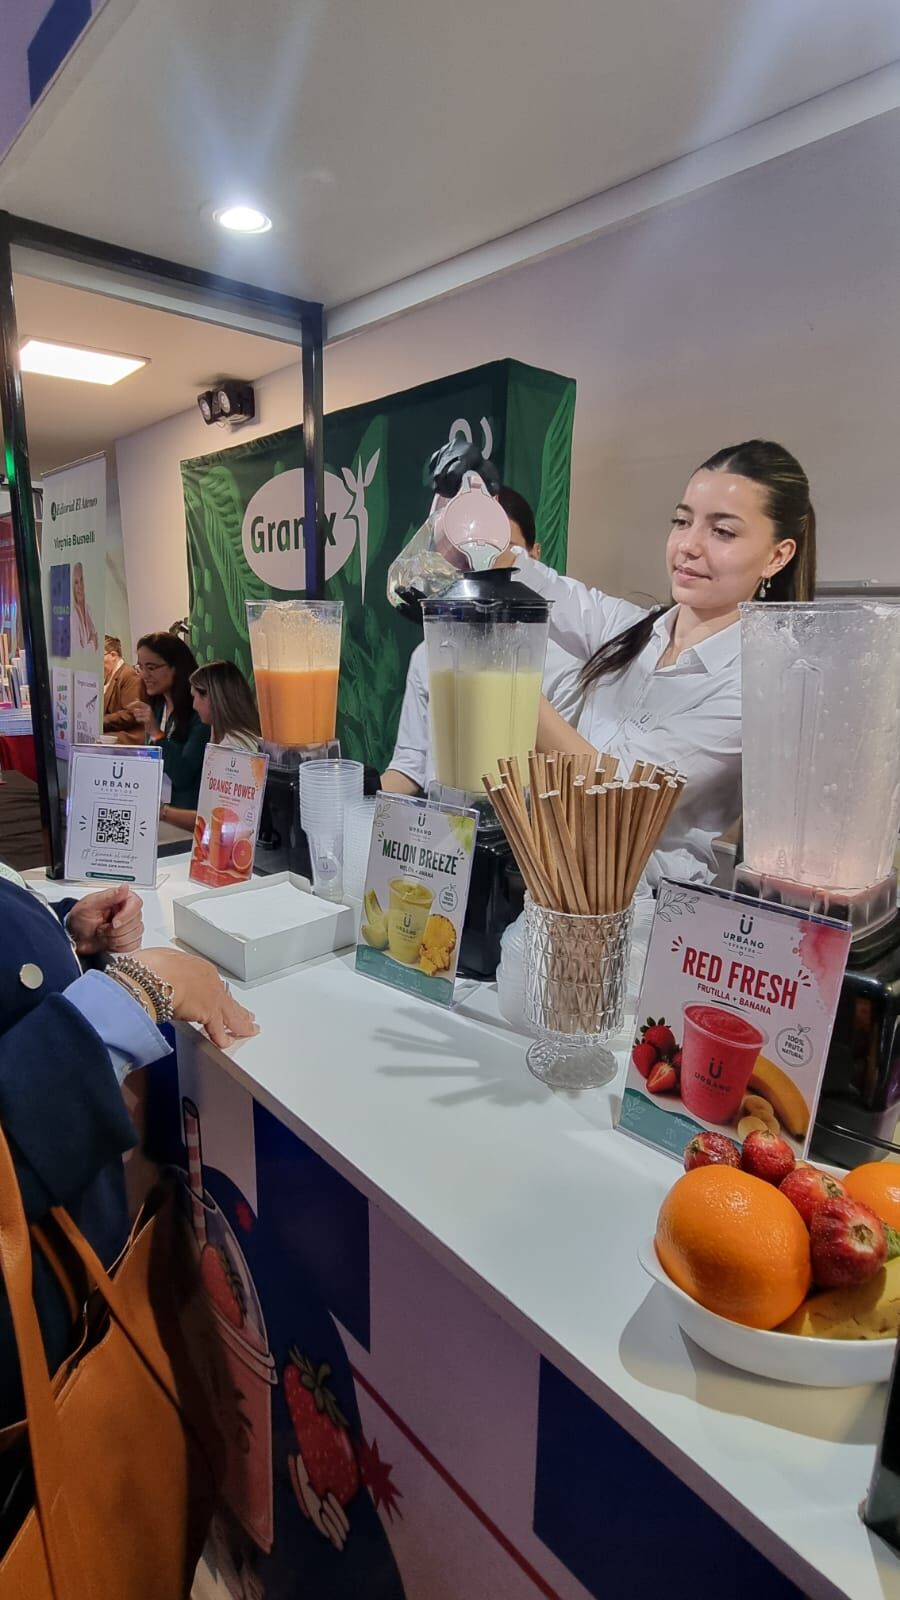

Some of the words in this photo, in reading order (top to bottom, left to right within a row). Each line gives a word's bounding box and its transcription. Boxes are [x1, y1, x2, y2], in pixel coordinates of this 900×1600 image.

[251, 512, 337, 554] Granx
[94, 779, 140, 789] URBANO
[208, 777, 233, 795] ORANGE
[233, 783, 256, 801] POWER
[382, 838, 417, 864] MELON
[418, 848, 459, 875] BREEZE
[723, 931, 765, 949] URBANO
[682, 946, 723, 983] RED
[727, 961, 798, 1010] FRESH
[697, 983, 730, 1001] FRUTILLA
[739, 998, 771, 1015] BANANA
[784, 1041, 804, 1053] FRUTA
[787, 1034, 804, 1047] 100%
[781, 1047, 804, 1060] NATURAL
